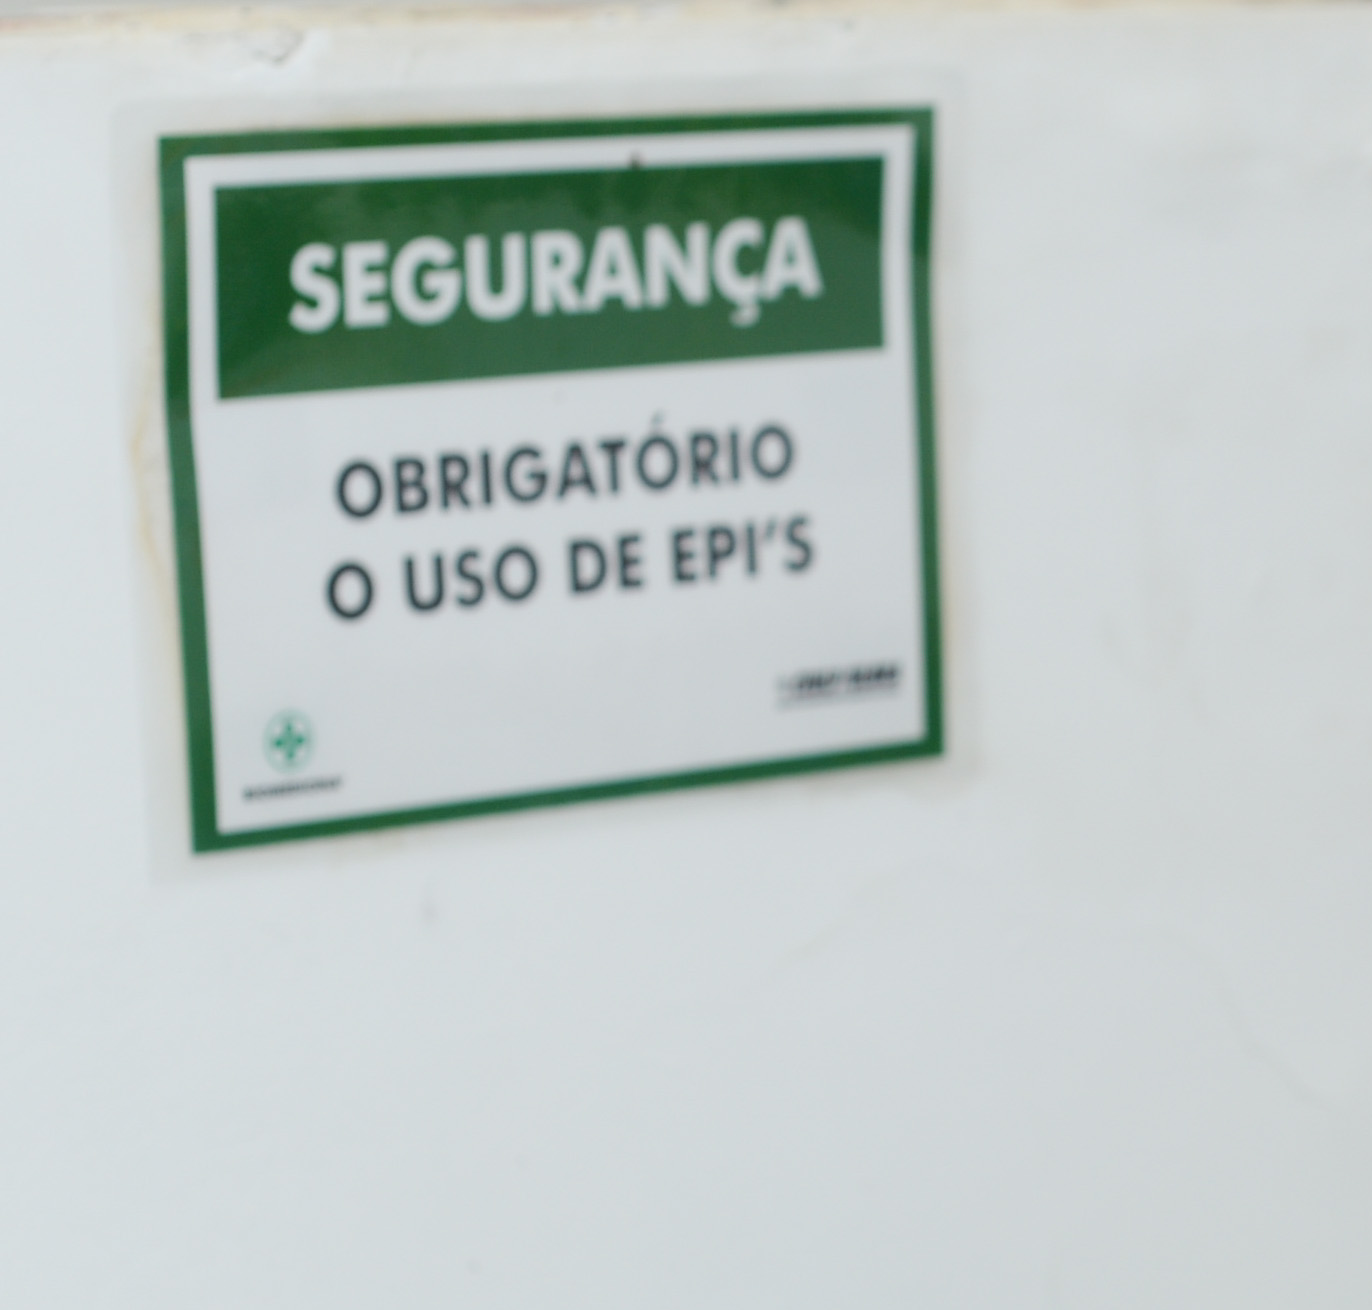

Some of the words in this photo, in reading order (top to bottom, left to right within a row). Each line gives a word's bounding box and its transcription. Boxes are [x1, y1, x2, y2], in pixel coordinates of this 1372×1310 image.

[288, 215, 824, 334] SEGURANÇA
[334, 414, 796, 520] OBRIGATÓRIO
[324, 561, 376, 621] O
[405, 544, 540, 613] USO
[568, 532, 643, 594] DE
